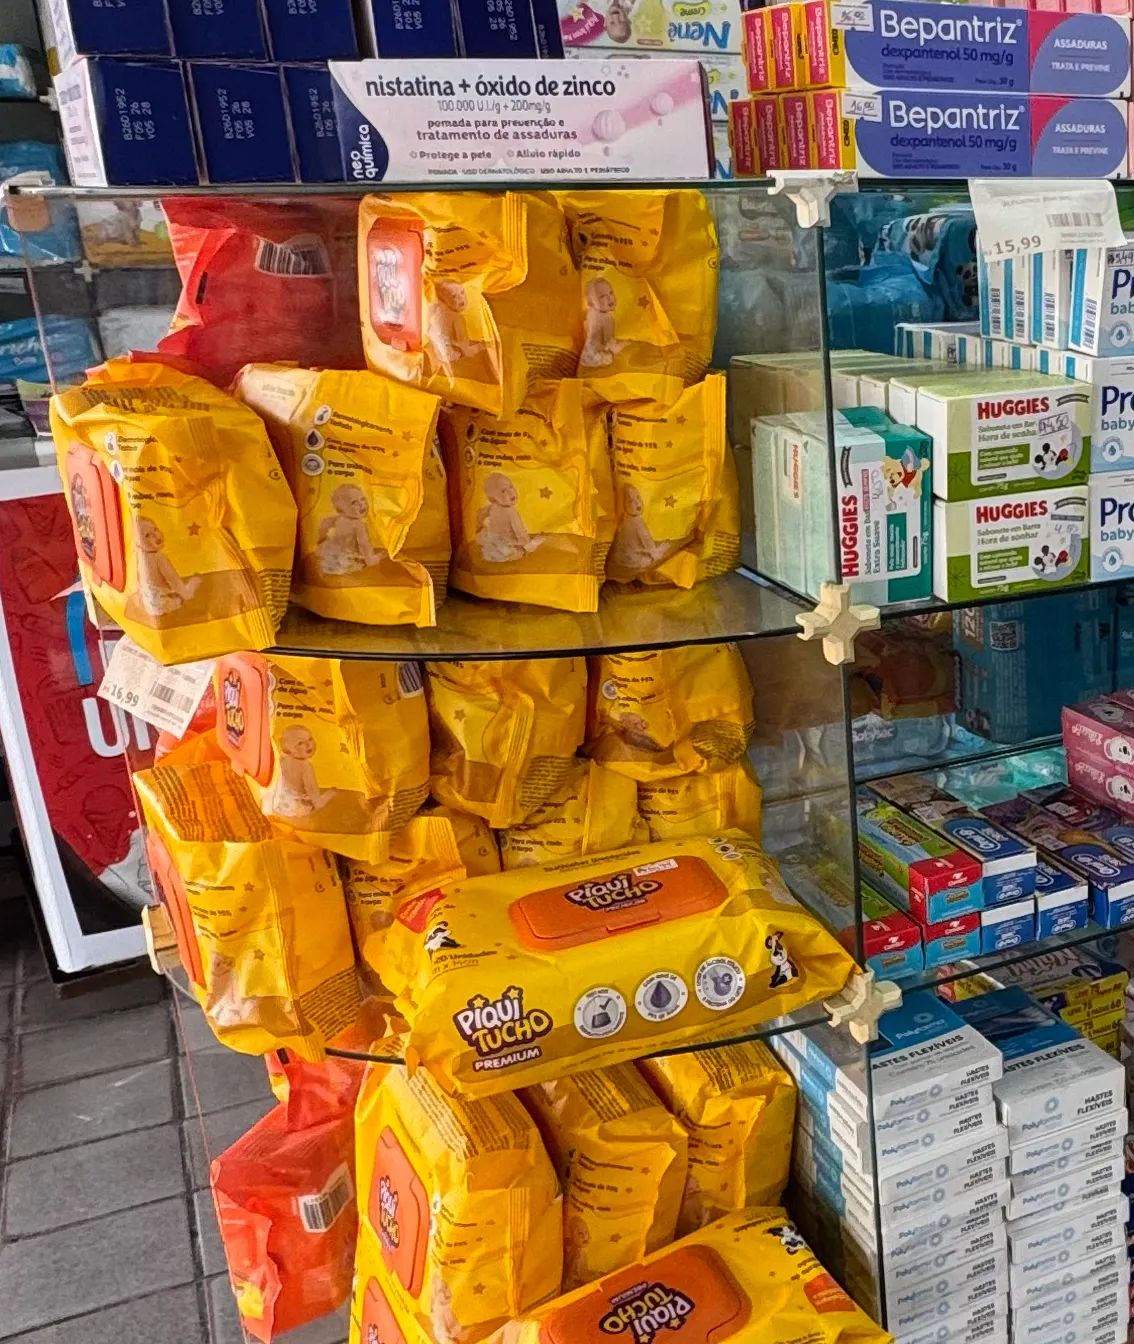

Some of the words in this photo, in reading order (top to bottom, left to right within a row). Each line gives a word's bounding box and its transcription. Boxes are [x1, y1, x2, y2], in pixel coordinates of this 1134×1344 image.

[880, 10, 1018, 45] Bepantriz
[881, 44, 961, 64] dexpantenol
[963, 48, 978, 60] 50
[980, 50, 1014, 66] mg/g
[1054, 38, 1107, 50] ASSADURAS
[366, 75, 455, 96] nistatina
[459, 80, 470, 93] +
[476, 75, 530, 96] óxido
[535, 75, 558, 96] de
[563, 75, 616, 96] zinco
[428, 119, 471, 128] pomada
[475, 119, 498, 129] para
[501, 118, 555, 129] prevenção
[890, 100, 1020, 134] Bepantriz
[417, 130, 490, 140] tratamento
[494, 130, 508, 139] de
[513, 130, 577, 139] assaduras
[1055, 124, 1105, 134] ASSADURAS
[359, 124, 375, 178] química
[890, 134, 968, 150] dexpantenol
[969, 136, 982, 147] 50
[985, 136, 1016, 152] mg/g
[353, 151, 364, 178] neo
[419, 150, 458, 161] Protege
[472, 150, 491, 161] pele
[995, 235, 1041, 256] 15,99
[977, 397, 1049, 420] HUGGIES
[976, 500, 1048, 524] HUGGIES
[841, 495, 859, 577] HUGGIES
[1101, 529, 1134, 542] baby
[111, 683, 139, 707] 16,99
[566, 875, 630, 902] PIQUI
[583, 879, 660, 907] TUCHO
[457, 995, 523, 1035] PIQUI
[472, 1012, 552, 1056] TUCHO
[474, 1048, 540, 1071] PREMIUM
[872, 1054, 907, 1070] ASTES
[909, 1035, 963, 1057] FLEXÍVEIS
[1077, 1098, 1113, 1115] FLEXÍVEIS
[1085, 1091, 1113, 1104] HASTES
[602, 1288, 673, 1332] TUCHO
[634, 1297, 692, 1337] PIQUI
